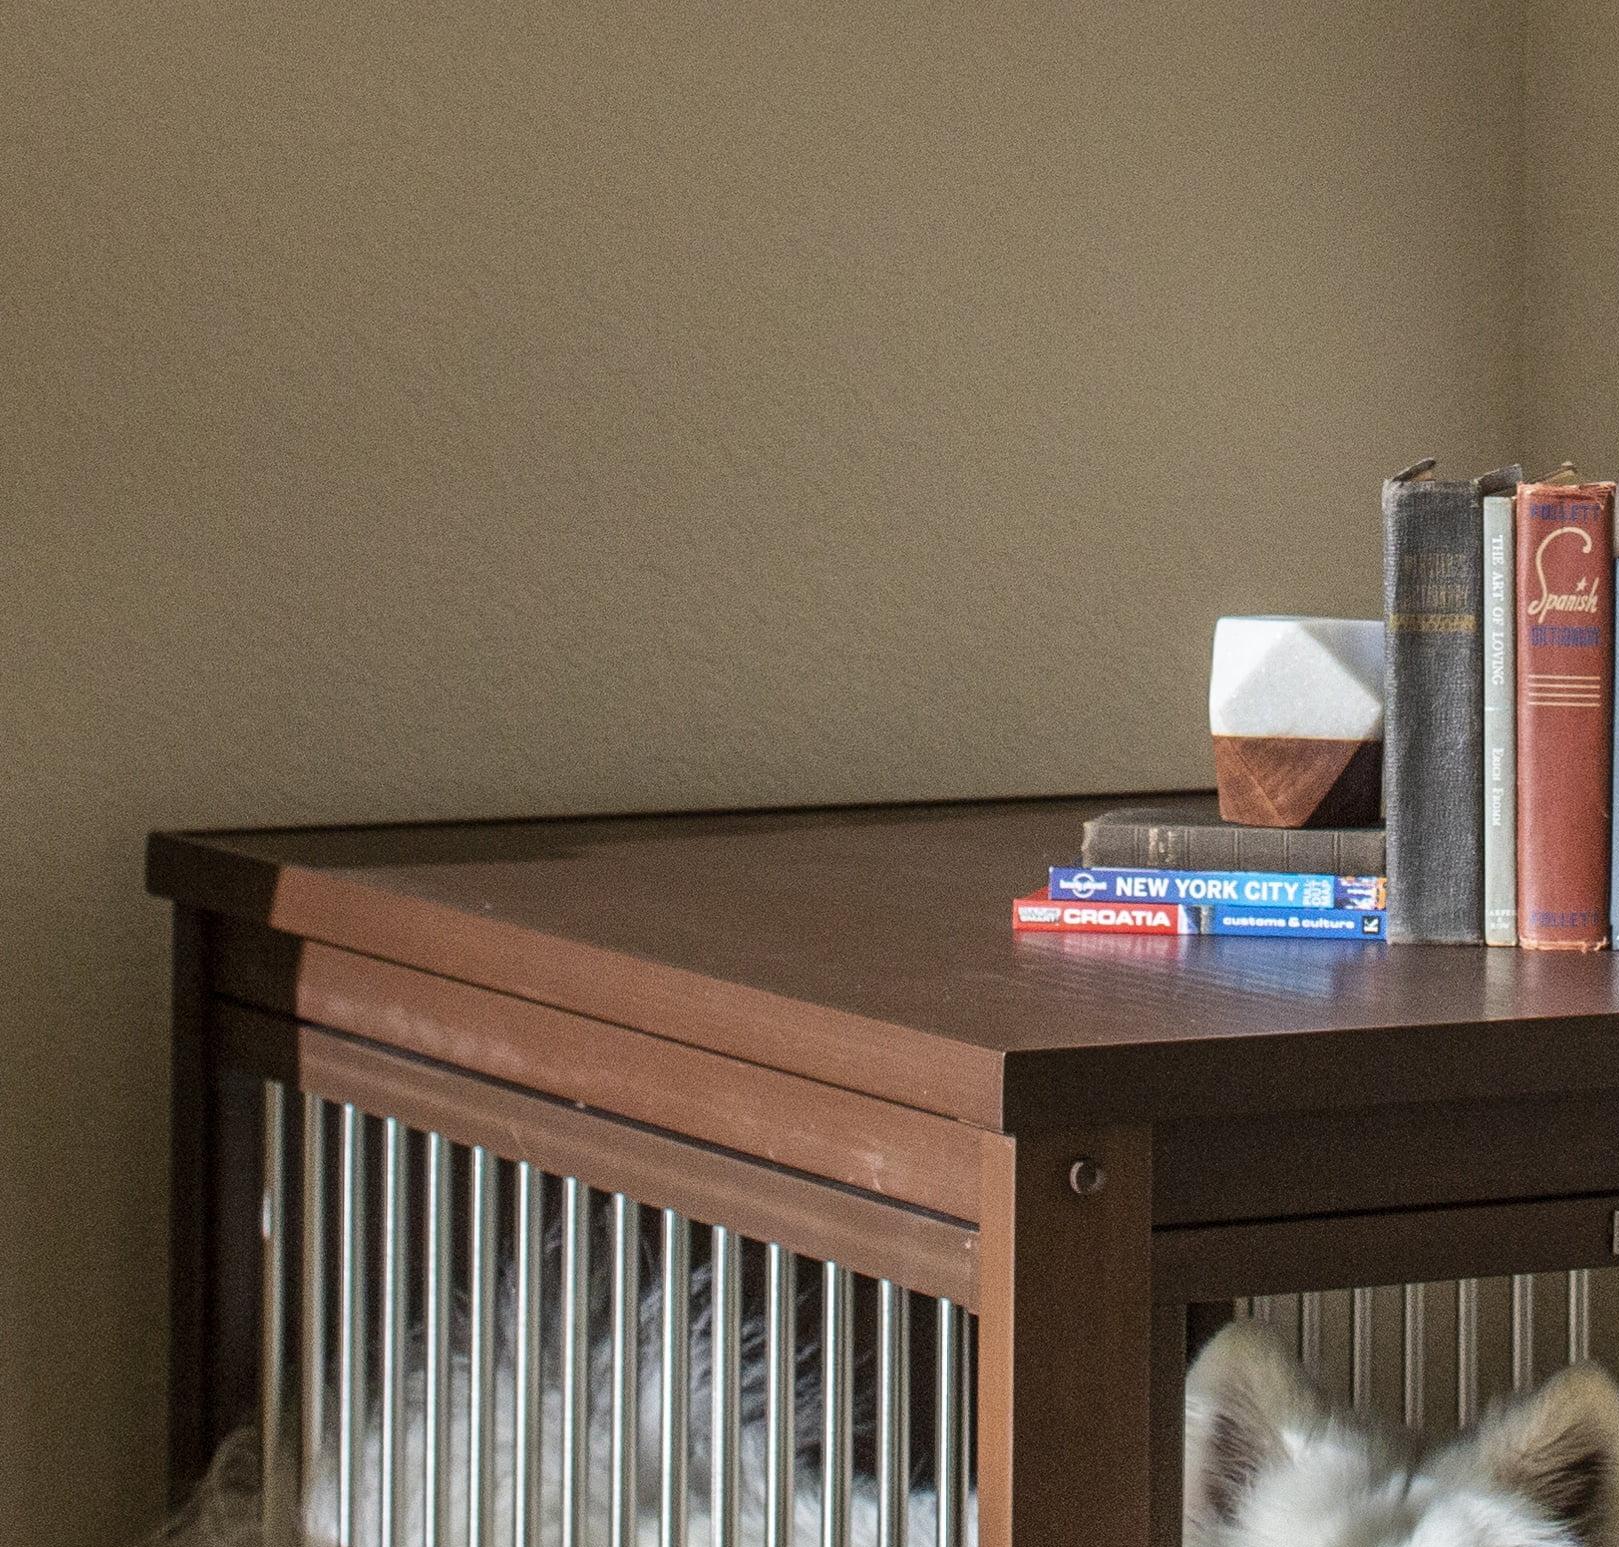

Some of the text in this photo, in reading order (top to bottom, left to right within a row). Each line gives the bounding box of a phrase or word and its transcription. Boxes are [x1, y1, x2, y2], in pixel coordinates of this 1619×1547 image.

[1528, 526, 1600, 624] Spanish
[1492, 535, 1504, 686] THE ART OF LOVING
[1115, 876, 1299, 902] NEW YORK CITY
[1063, 908, 1172, 927] CROATIA
[1222, 916, 1355, 930] customs & culture
